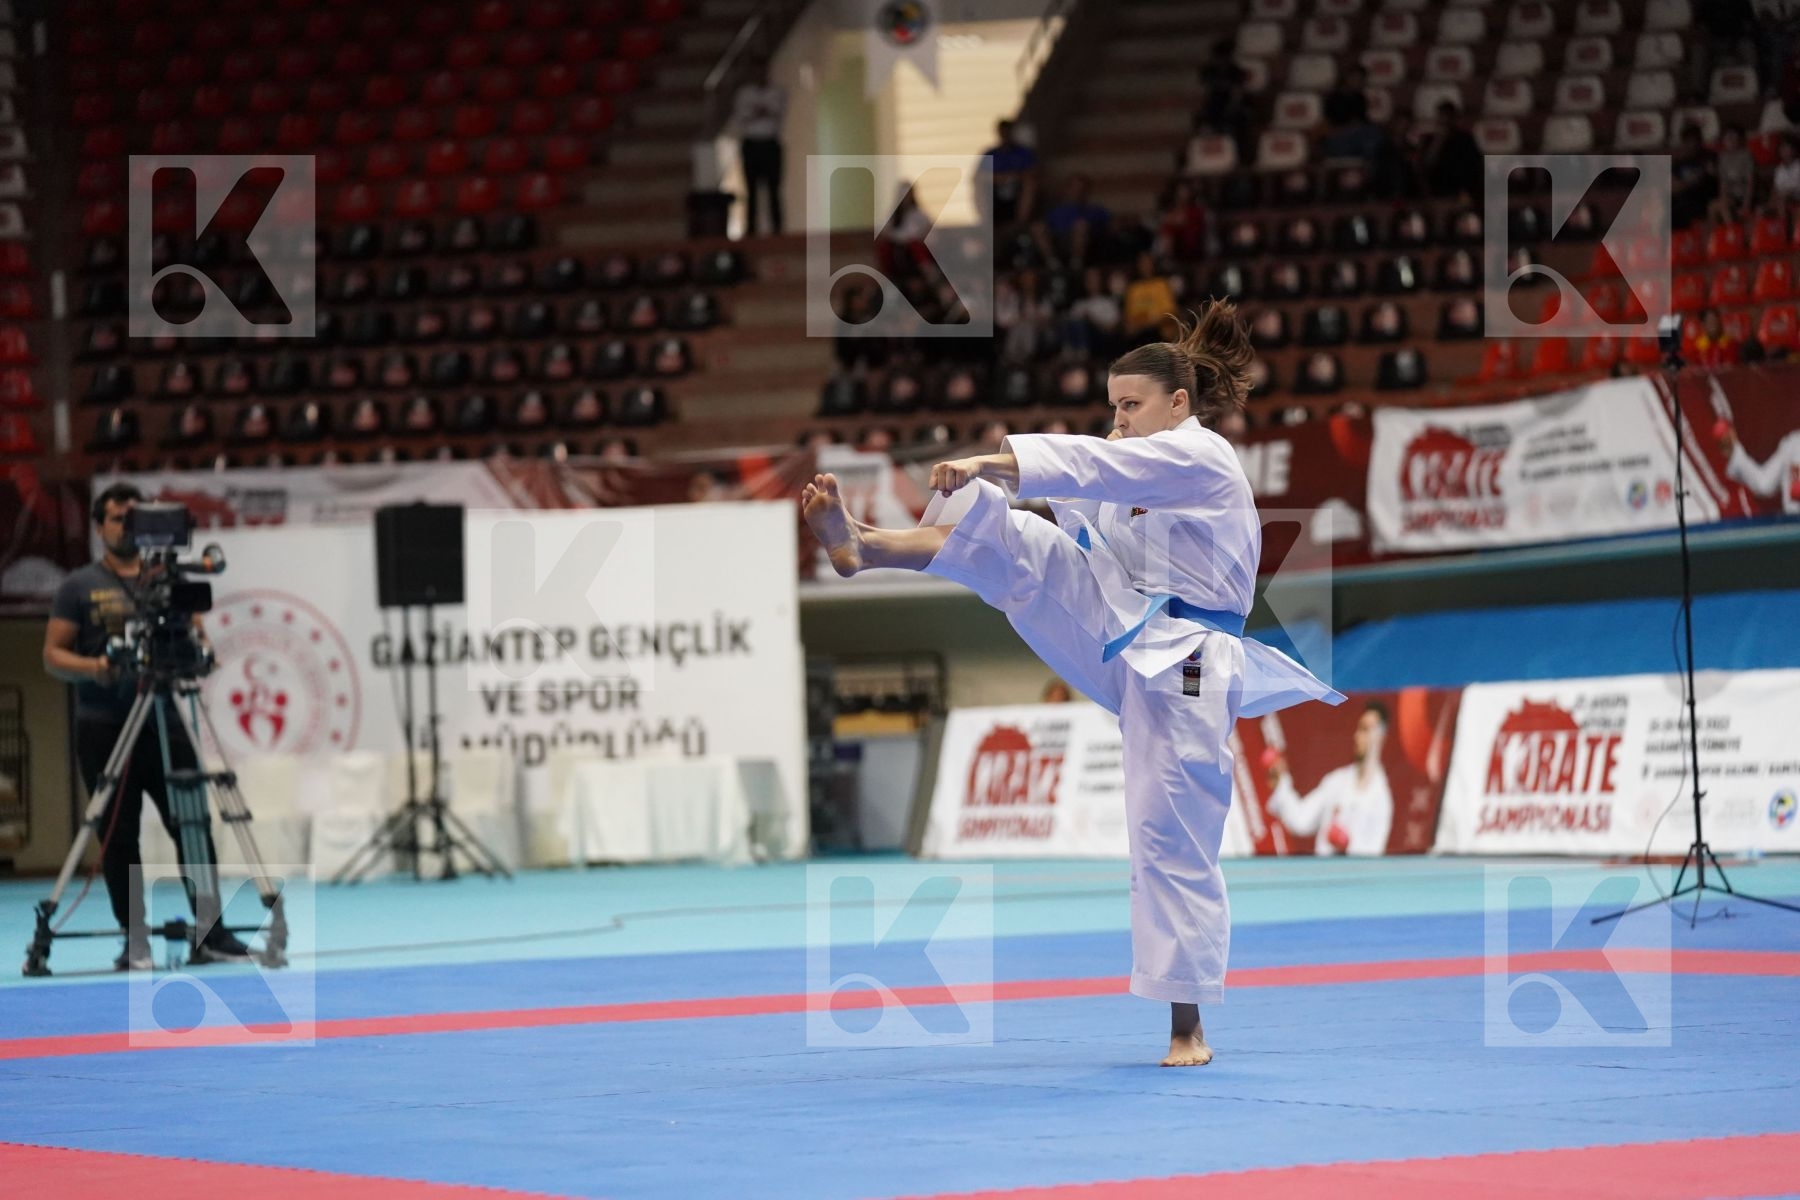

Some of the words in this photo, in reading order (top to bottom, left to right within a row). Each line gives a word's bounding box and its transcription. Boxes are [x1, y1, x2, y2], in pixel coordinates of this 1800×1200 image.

[587, 611, 753, 667] GENÇLİK
[480, 682, 527, 717] VE
[536, 678, 641, 715] SPOR
